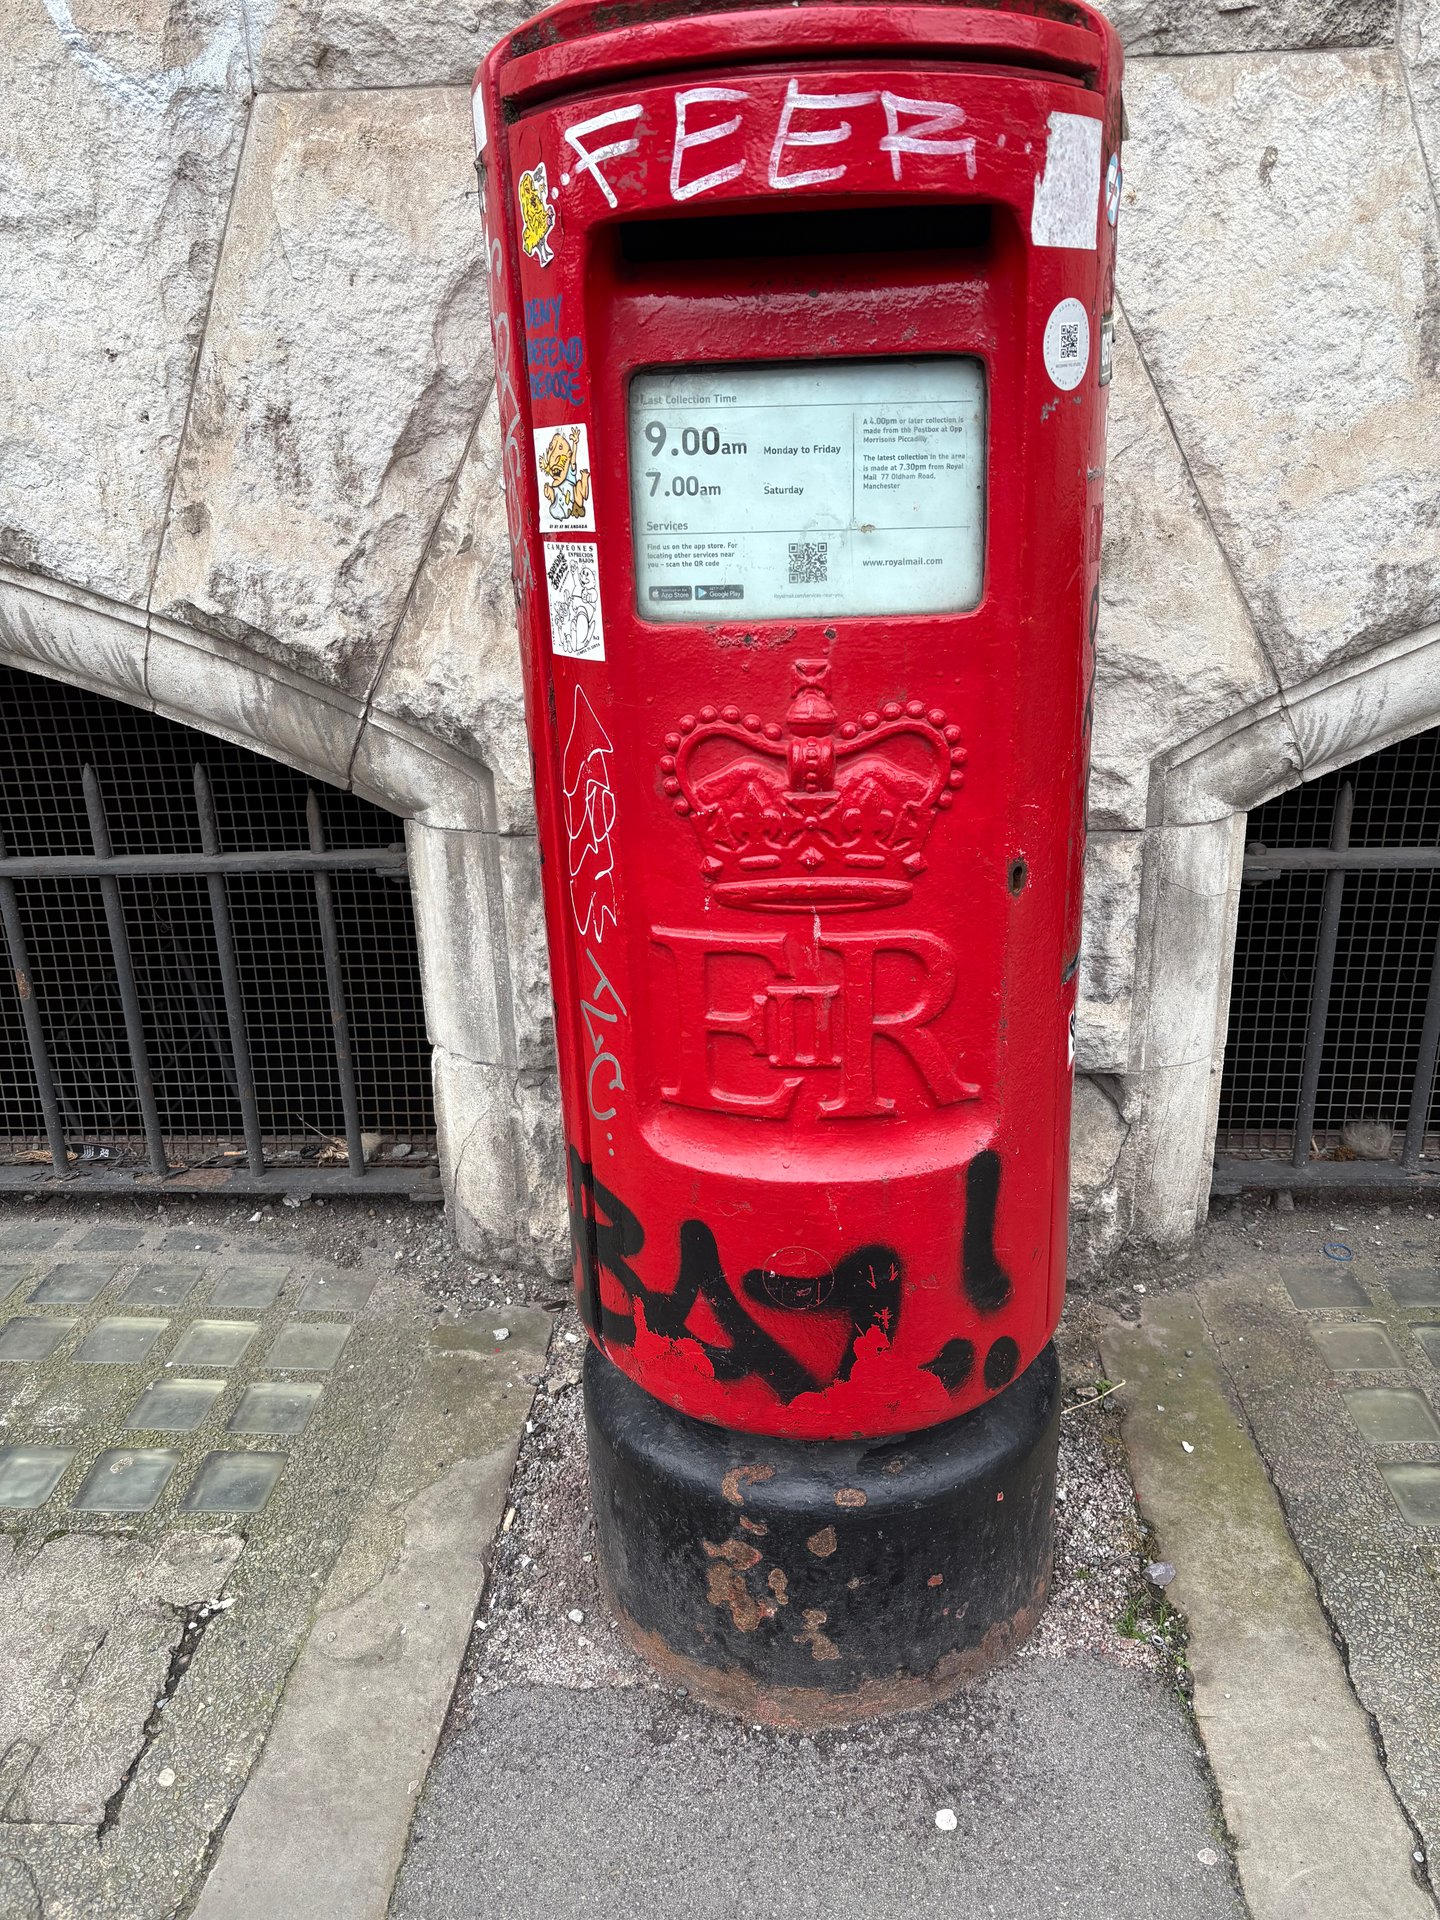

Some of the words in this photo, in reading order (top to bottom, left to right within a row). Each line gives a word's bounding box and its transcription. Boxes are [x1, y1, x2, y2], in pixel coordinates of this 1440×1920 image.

[525, 293, 562, 332] DENY
[527, 336, 583, 369] DEFEND
[643, 396, 662, 405] Last
[665, 395, 710, 404] Collection
[713, 394, 737, 403] Time
[869, 417, 897, 426] 4.00pm
[925, 416, 956, 424] collection
[882, 426, 899, 434] from
[914, 425, 939, 433] Postbox
[949, 425, 963, 433] Opp
[645, 421, 747, 457] 9.00am
[897, 435, 927, 443] Piccadilly
[763, 445, 798, 456] Monday
[801, 446, 810, 454] to
[813, 444, 841, 455] Friday
[899, 463, 926, 471] 7.30pm
[946, 463, 964, 471] Royal
[645, 471, 721, 497] 7.00am
[763, 485, 804, 496] Saturday
[646, 521, 689, 531] Services
[546, 543, 594, 552] CAMPEONES
[862, 557, 943, 567] www.royalmail.com
